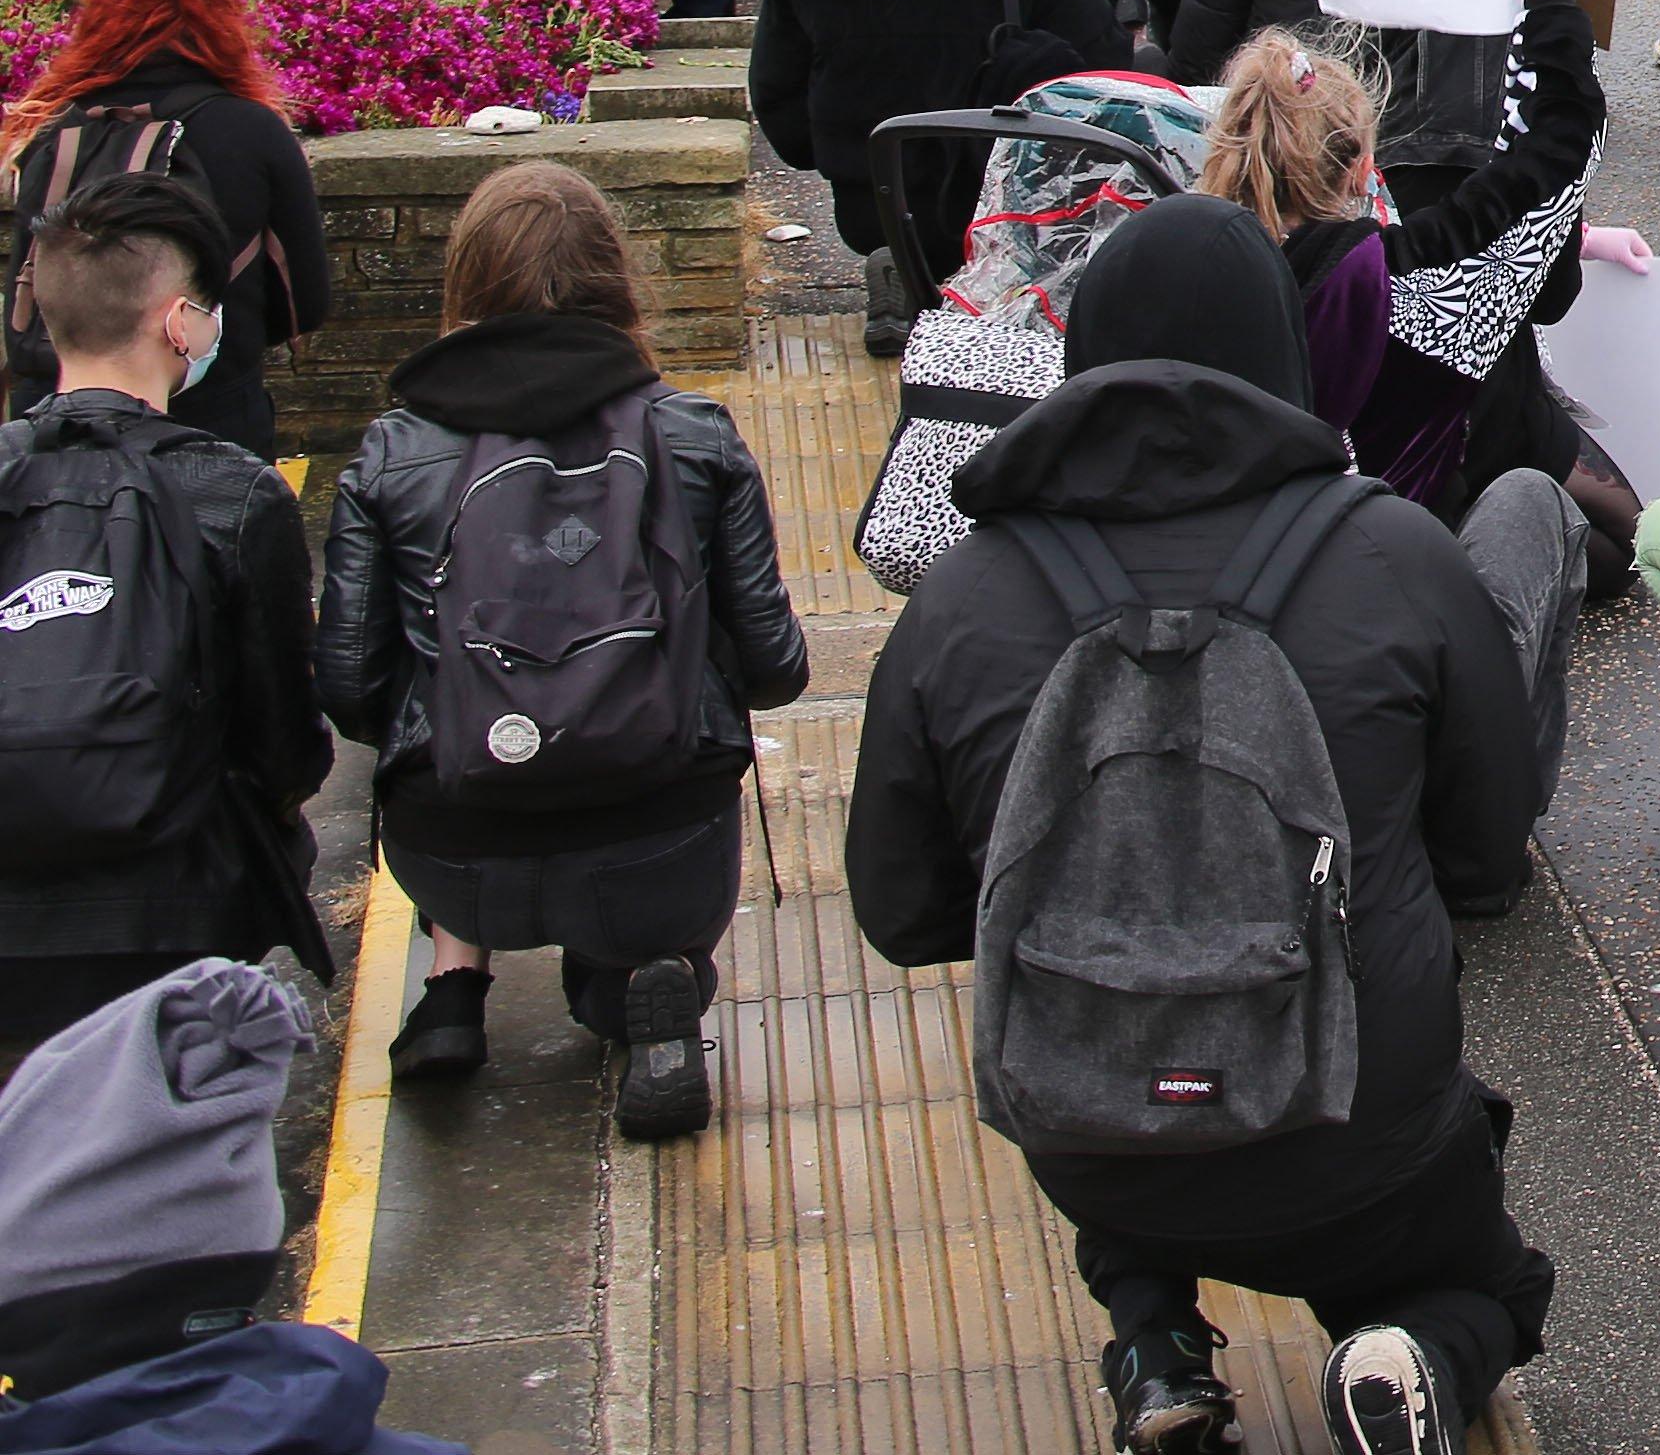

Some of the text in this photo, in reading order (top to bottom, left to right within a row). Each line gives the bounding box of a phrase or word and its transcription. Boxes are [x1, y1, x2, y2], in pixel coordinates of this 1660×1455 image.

[26, 577, 70, 601] VANS
[30, 592, 64, 613] THE
[1159, 1081, 1211, 1092] EASTPAK
